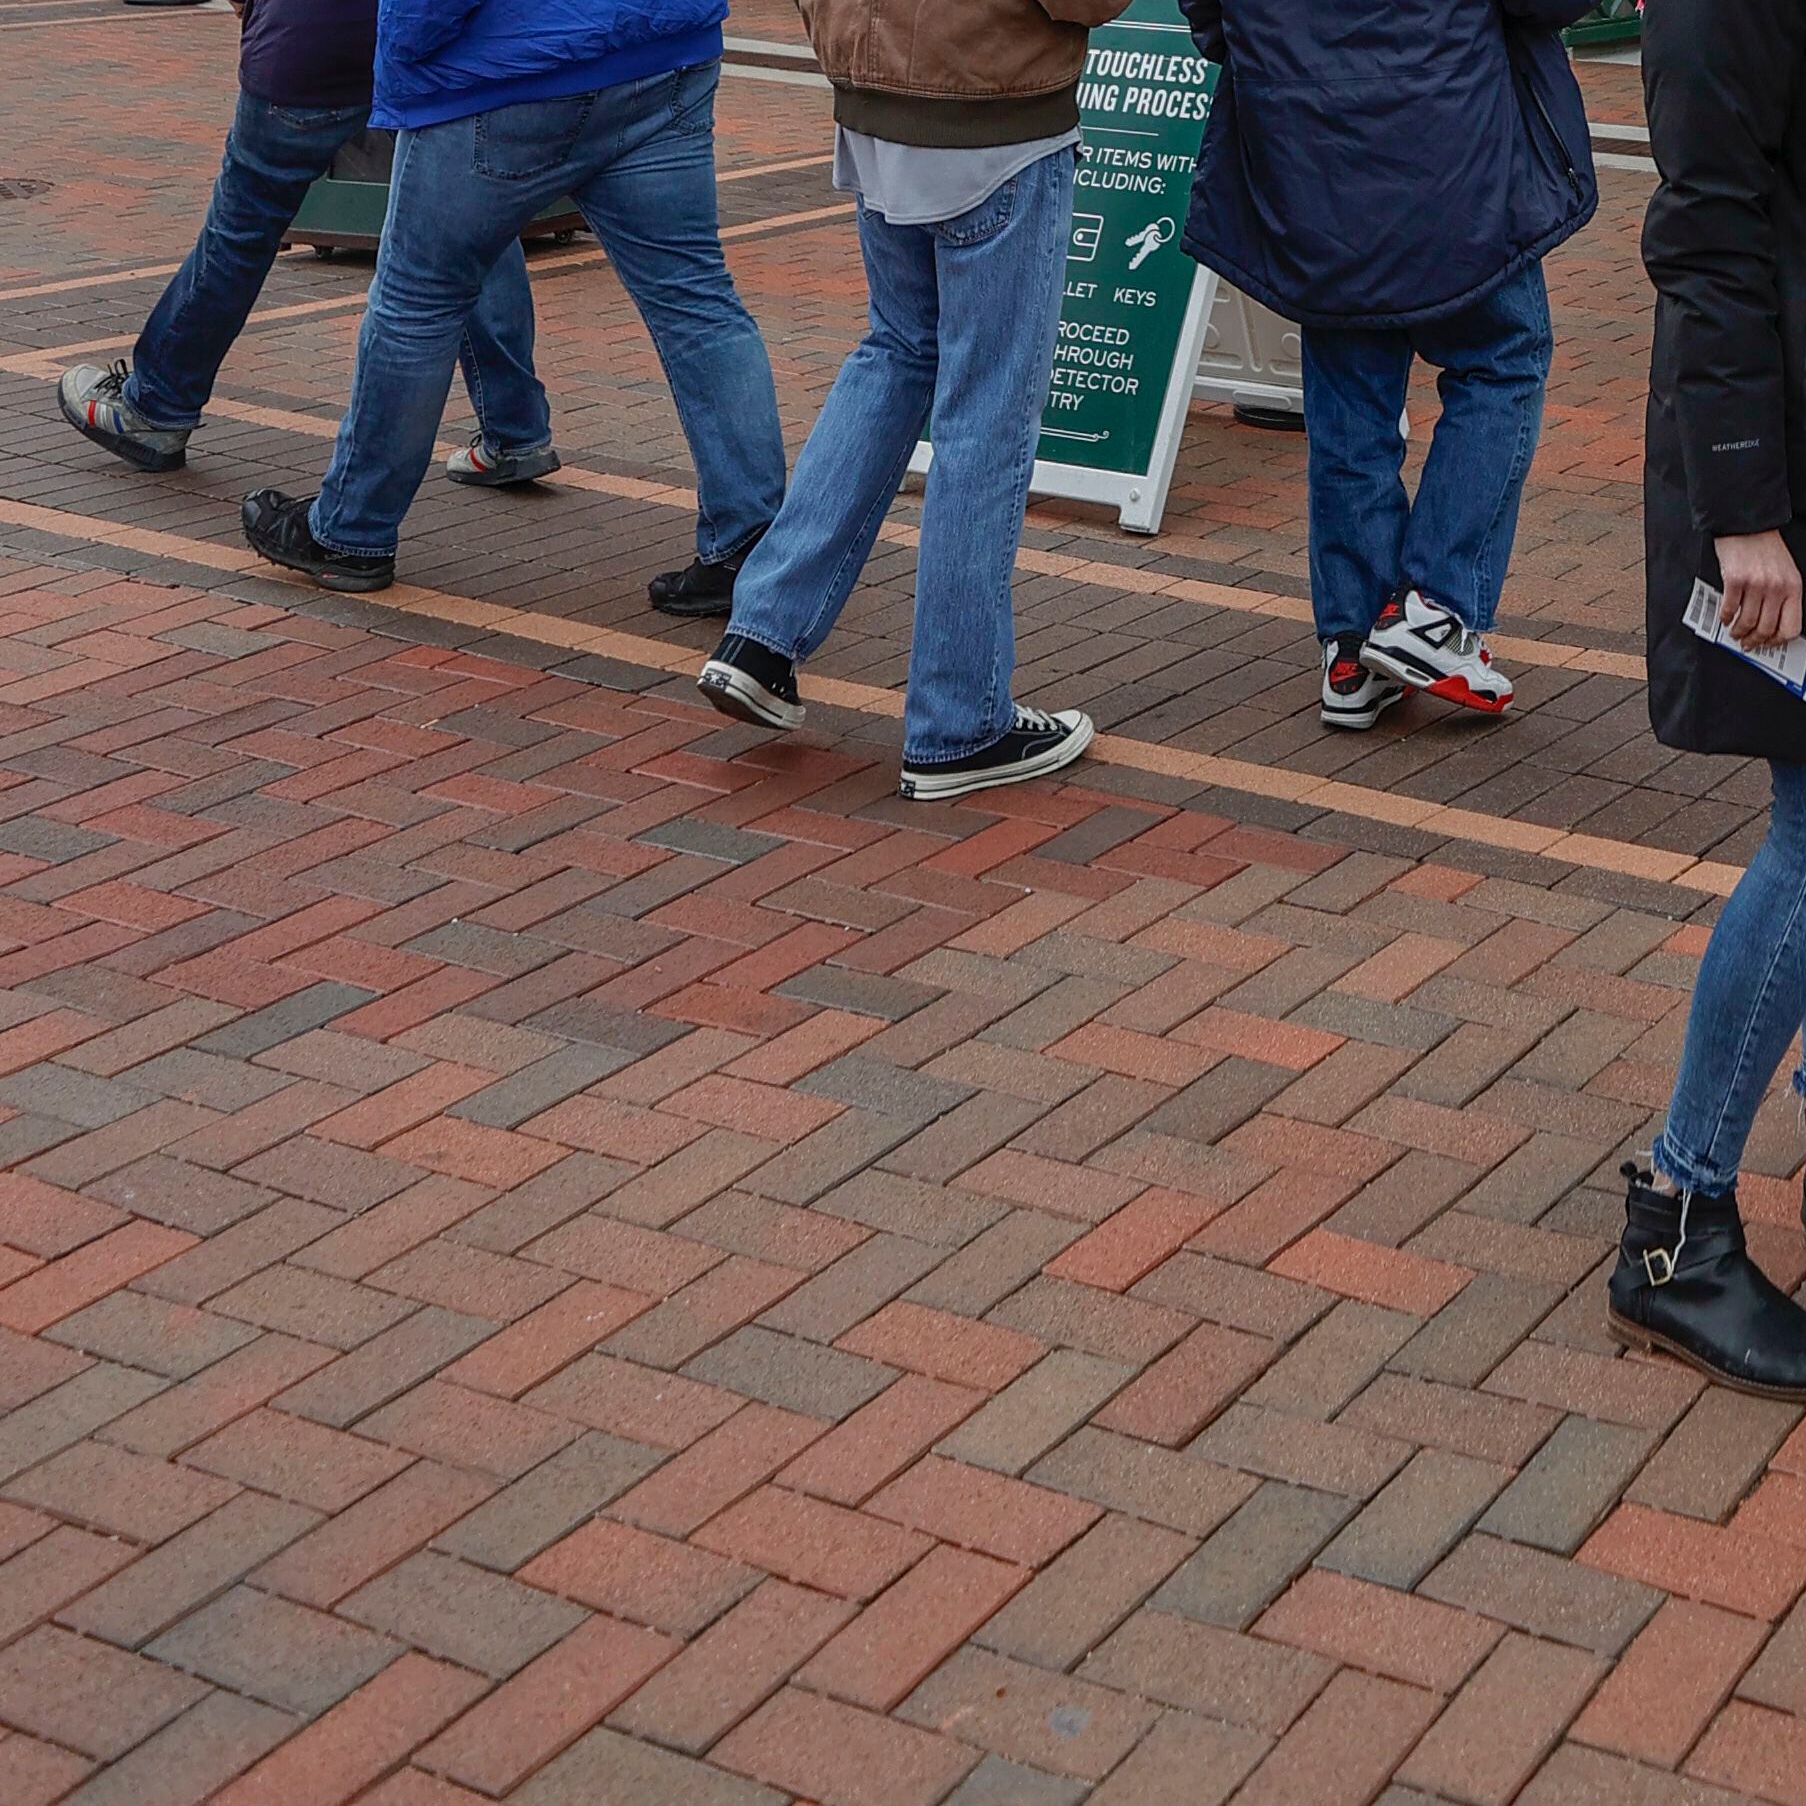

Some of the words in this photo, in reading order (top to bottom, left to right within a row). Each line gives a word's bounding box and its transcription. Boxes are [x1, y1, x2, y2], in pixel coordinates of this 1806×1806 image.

[1085, 48, 1208, 85] TOUCHLESS
[1122, 86, 1214, 121] PROCES
[1096, 147, 1153, 169] ITEMS
[1063, 280, 1098, 299] LET
[1113, 287, 1157, 307] KEYS
[1053, 344, 1134, 371] HROUGH
[1050, 391, 1084, 412] TRY
